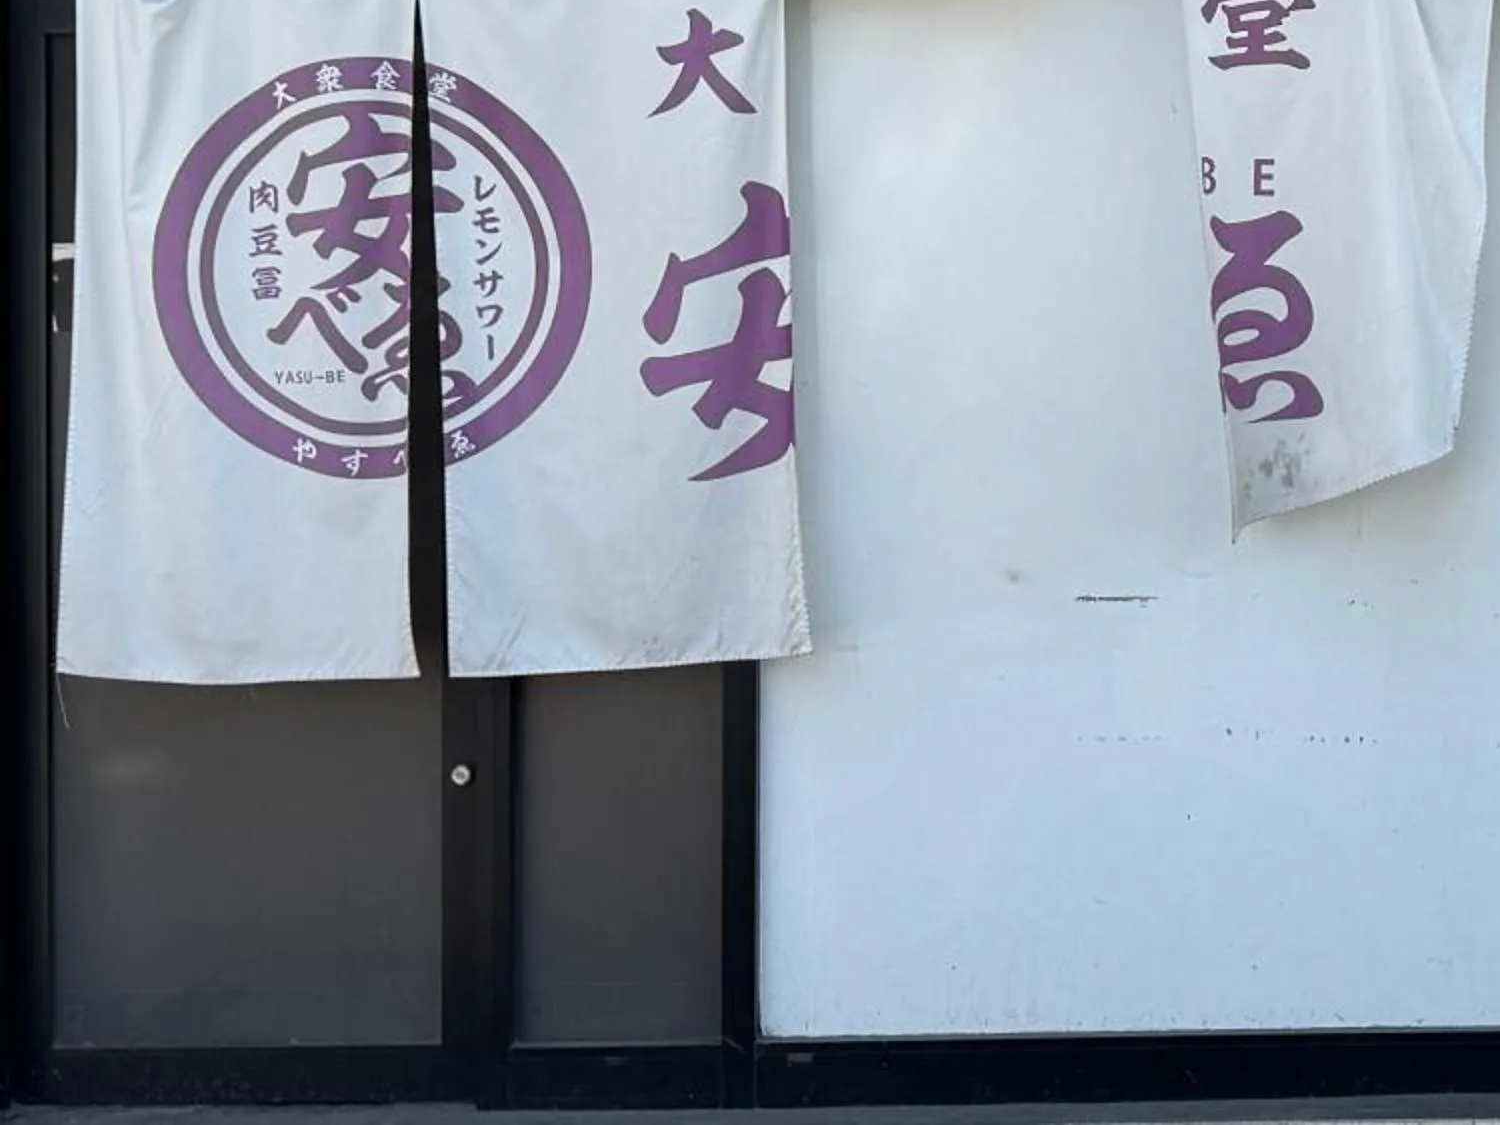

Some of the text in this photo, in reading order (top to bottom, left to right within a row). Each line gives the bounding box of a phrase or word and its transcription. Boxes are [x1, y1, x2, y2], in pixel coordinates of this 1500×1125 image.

[272, 60, 458, 110] 大衆食堂
[649, 9, 757, 117] 大
[471, 175, 504, 361] レモンサワー
[275, 370, 346, 384] YASU-BE
